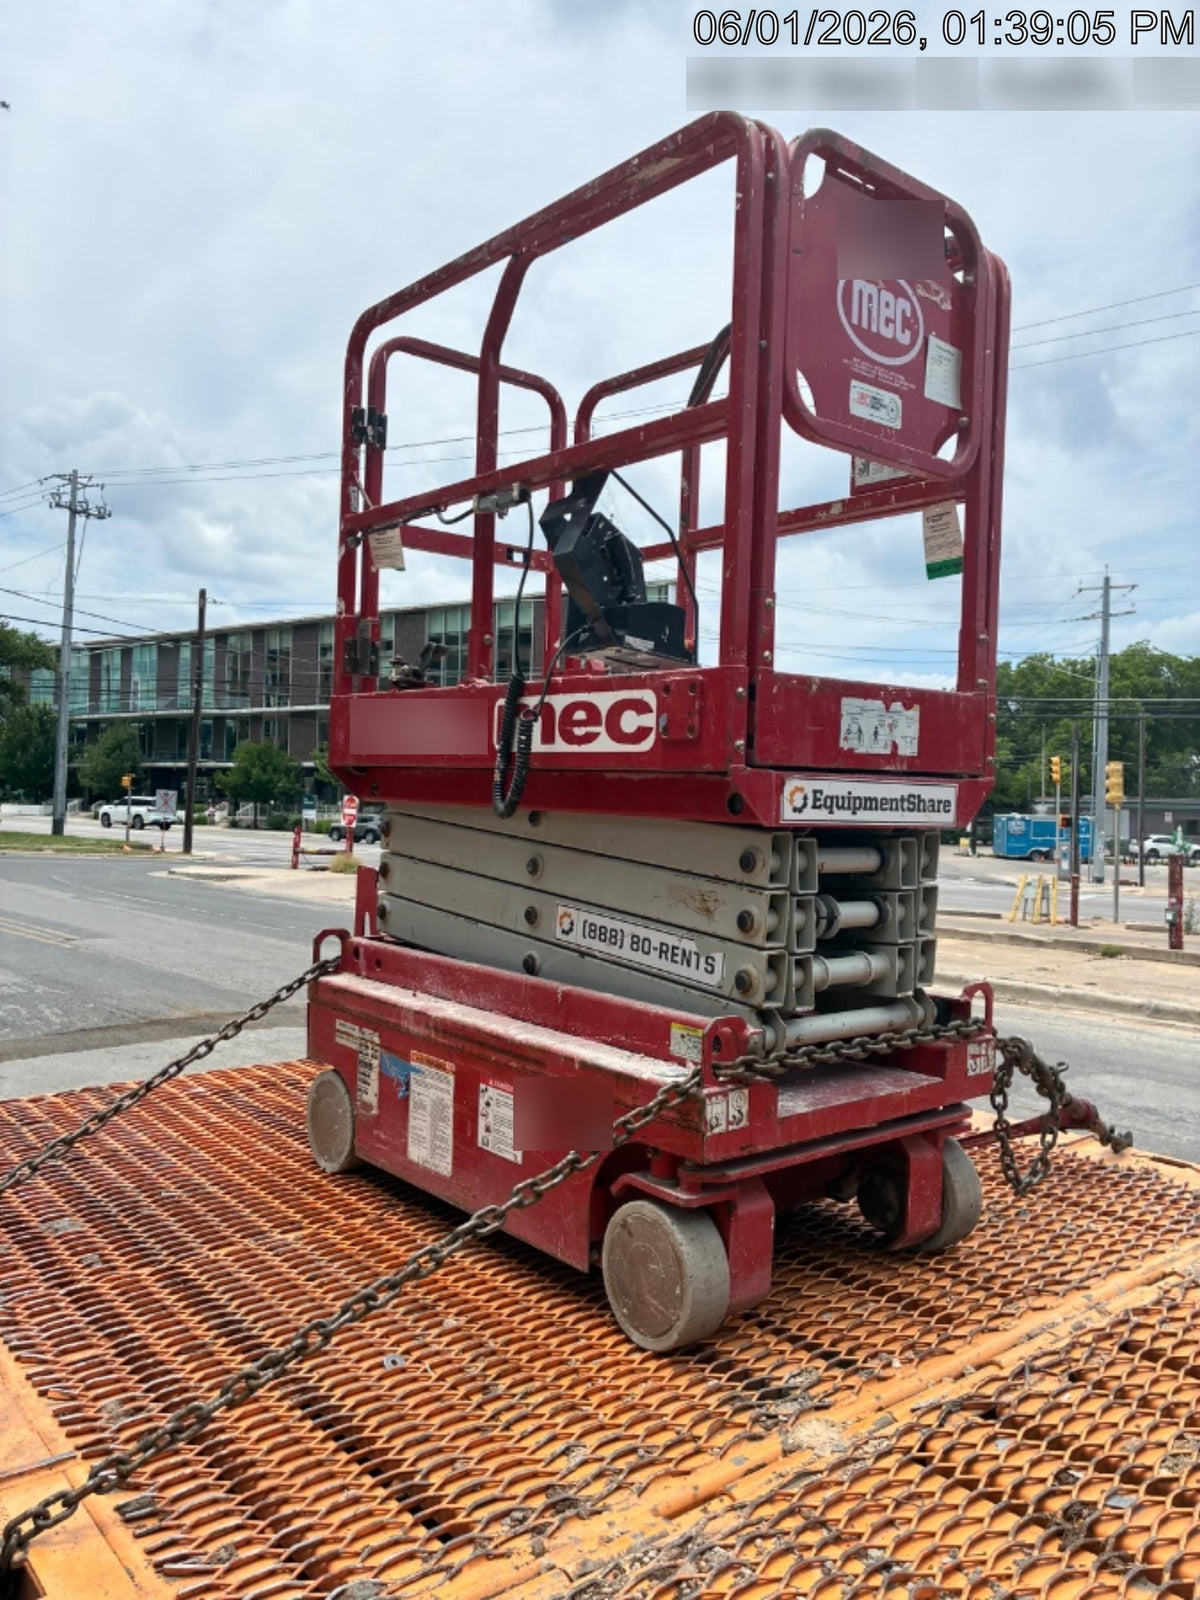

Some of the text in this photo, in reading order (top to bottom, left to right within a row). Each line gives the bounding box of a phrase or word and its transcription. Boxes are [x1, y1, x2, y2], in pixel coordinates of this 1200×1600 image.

[851, 279, 911, 346] mec
[811, 788, 952, 815] EquipmentShare
[582, 918, 625, 949] (888)
